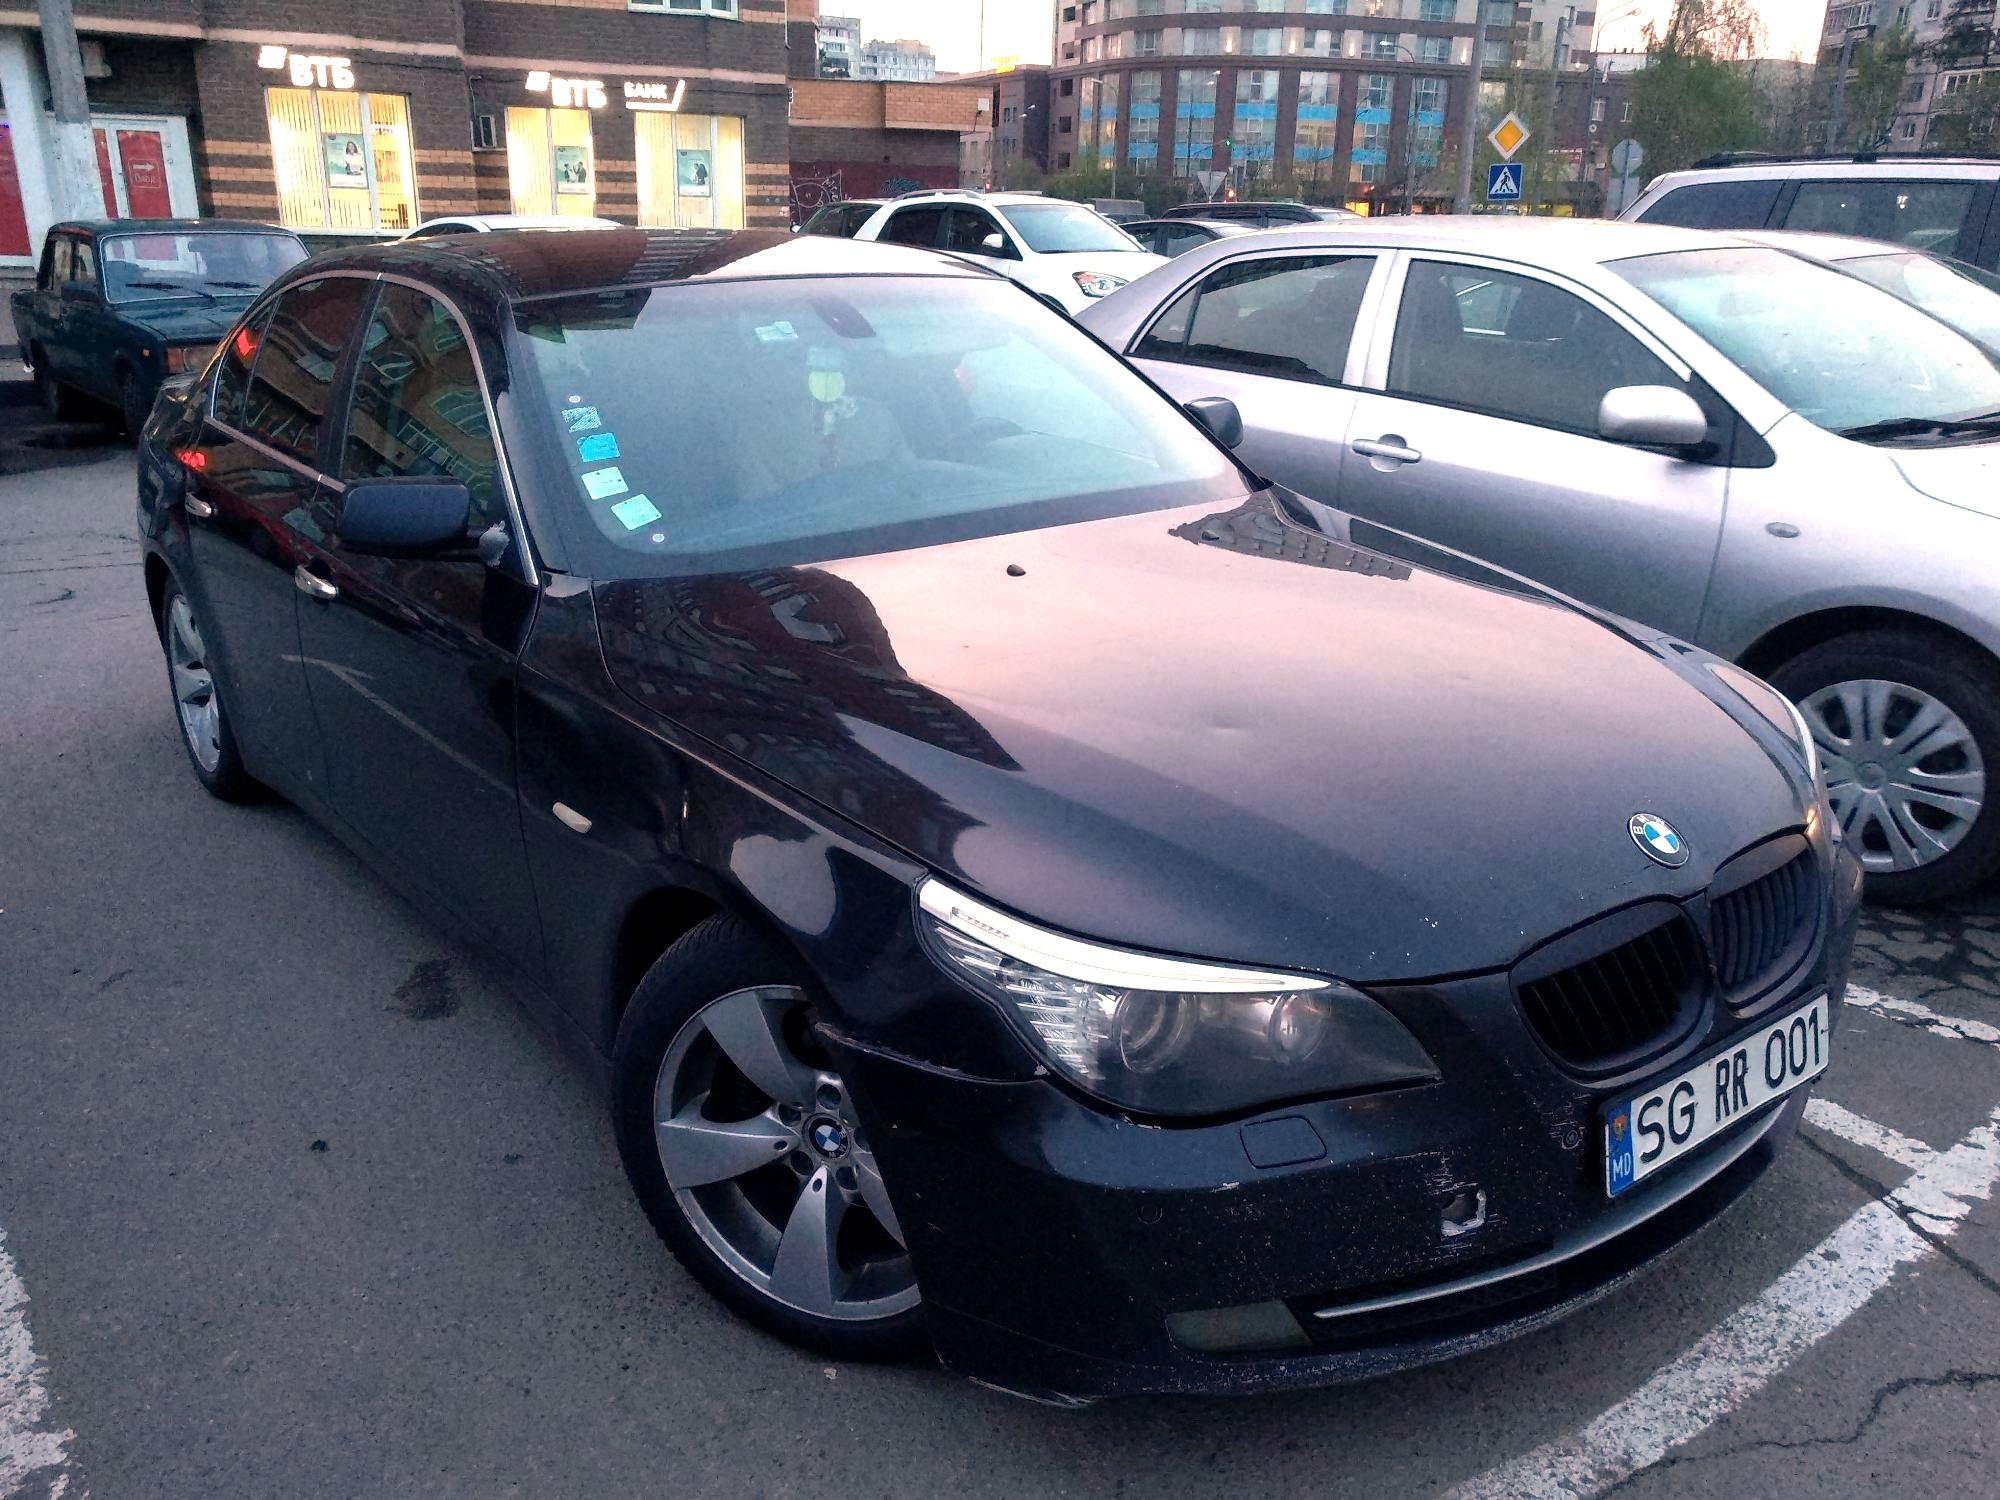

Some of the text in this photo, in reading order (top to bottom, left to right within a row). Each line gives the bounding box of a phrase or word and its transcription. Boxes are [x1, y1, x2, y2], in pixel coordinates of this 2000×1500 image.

[289, 54, 355, 89] ВТБ
[551, 78, 667, 108] ВТБ БАНК
[1637, 1006, 1820, 1163] SG RR 001
[1612, 1152, 1632, 1182] MD
